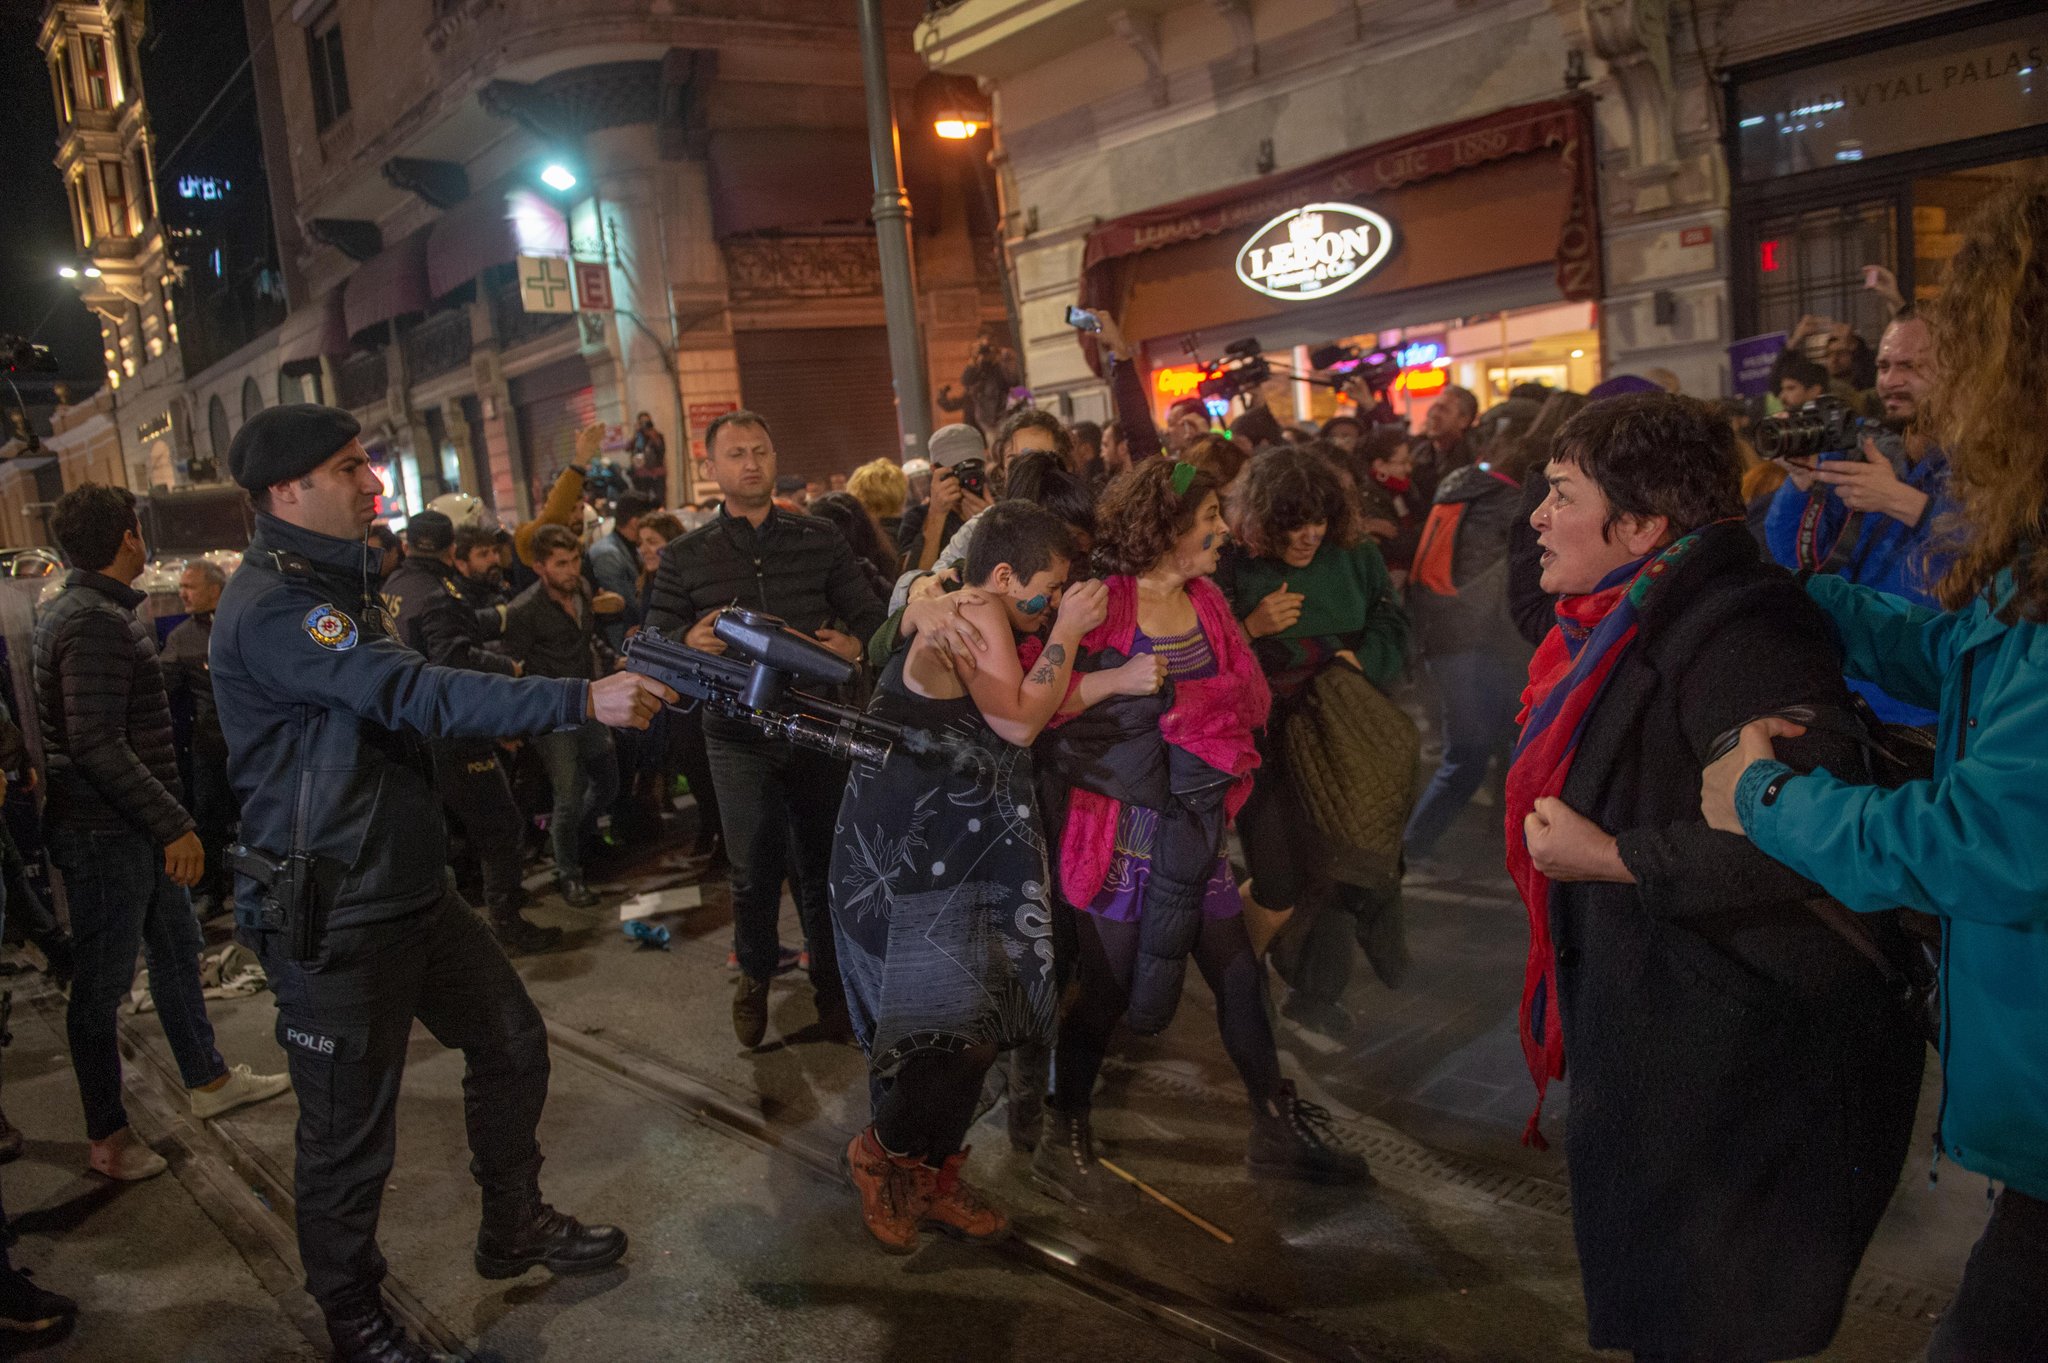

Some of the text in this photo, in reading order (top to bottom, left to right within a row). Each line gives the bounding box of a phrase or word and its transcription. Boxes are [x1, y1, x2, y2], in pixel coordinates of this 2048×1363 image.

[1943, 47, 2043, 88] PALAS
[1249, 225, 1370, 279] LEBON
[287, 1028, 335, 1054] POLİS
